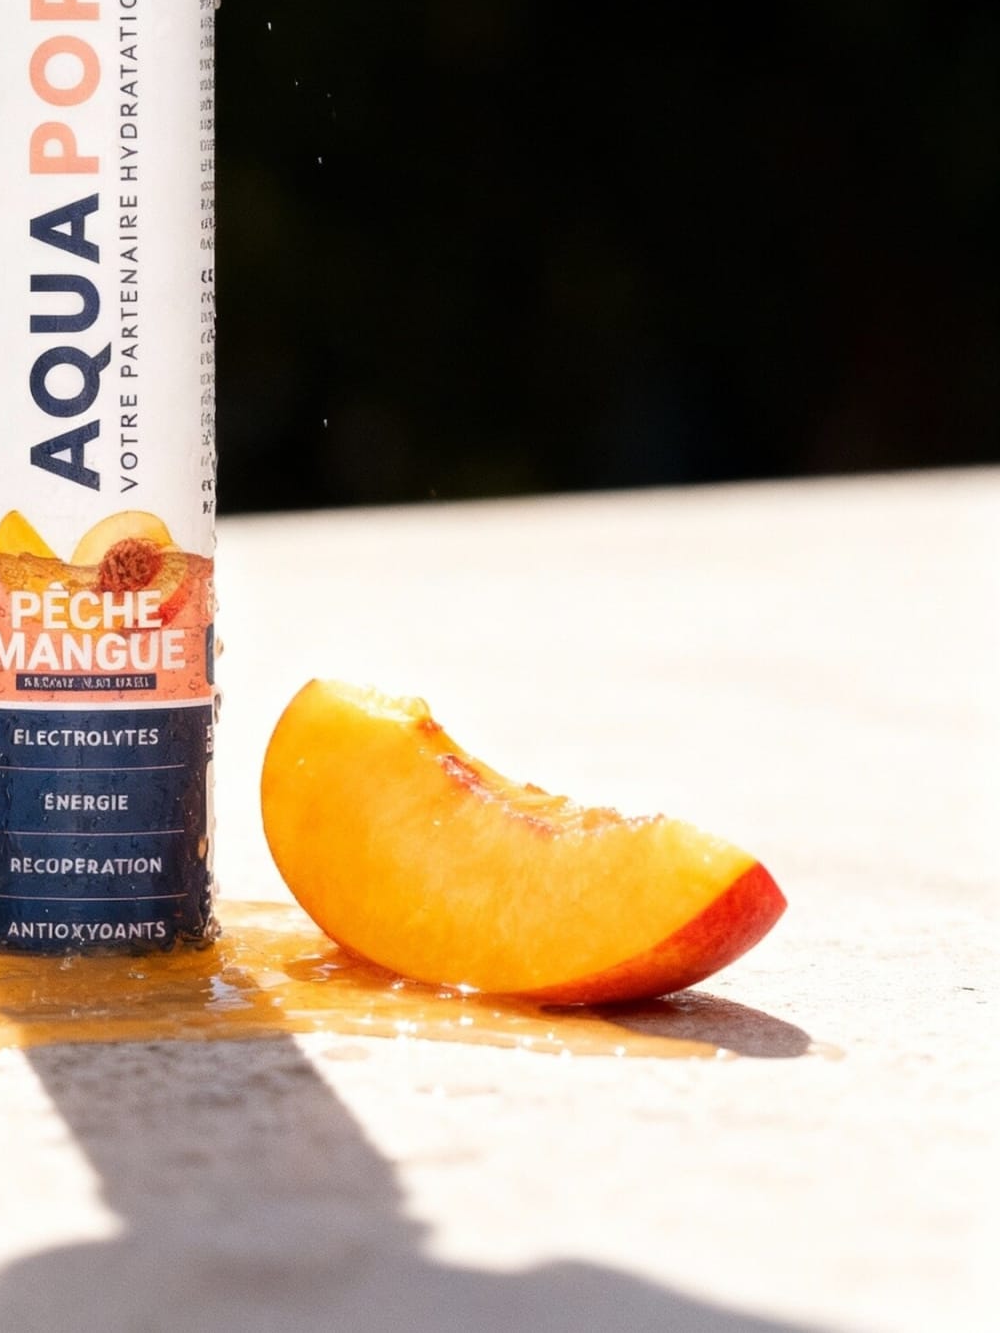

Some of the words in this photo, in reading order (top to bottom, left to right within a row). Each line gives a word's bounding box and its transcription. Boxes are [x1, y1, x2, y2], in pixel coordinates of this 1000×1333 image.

[119, 196, 138, 379] PARTENAIRE
[29, 193, 111, 492] AQUA
[119, 394, 139, 494] VOTRE
[10, 581, 163, 629] PÊCHE
[13, 728, 160, 747] ELECTROLYTES
